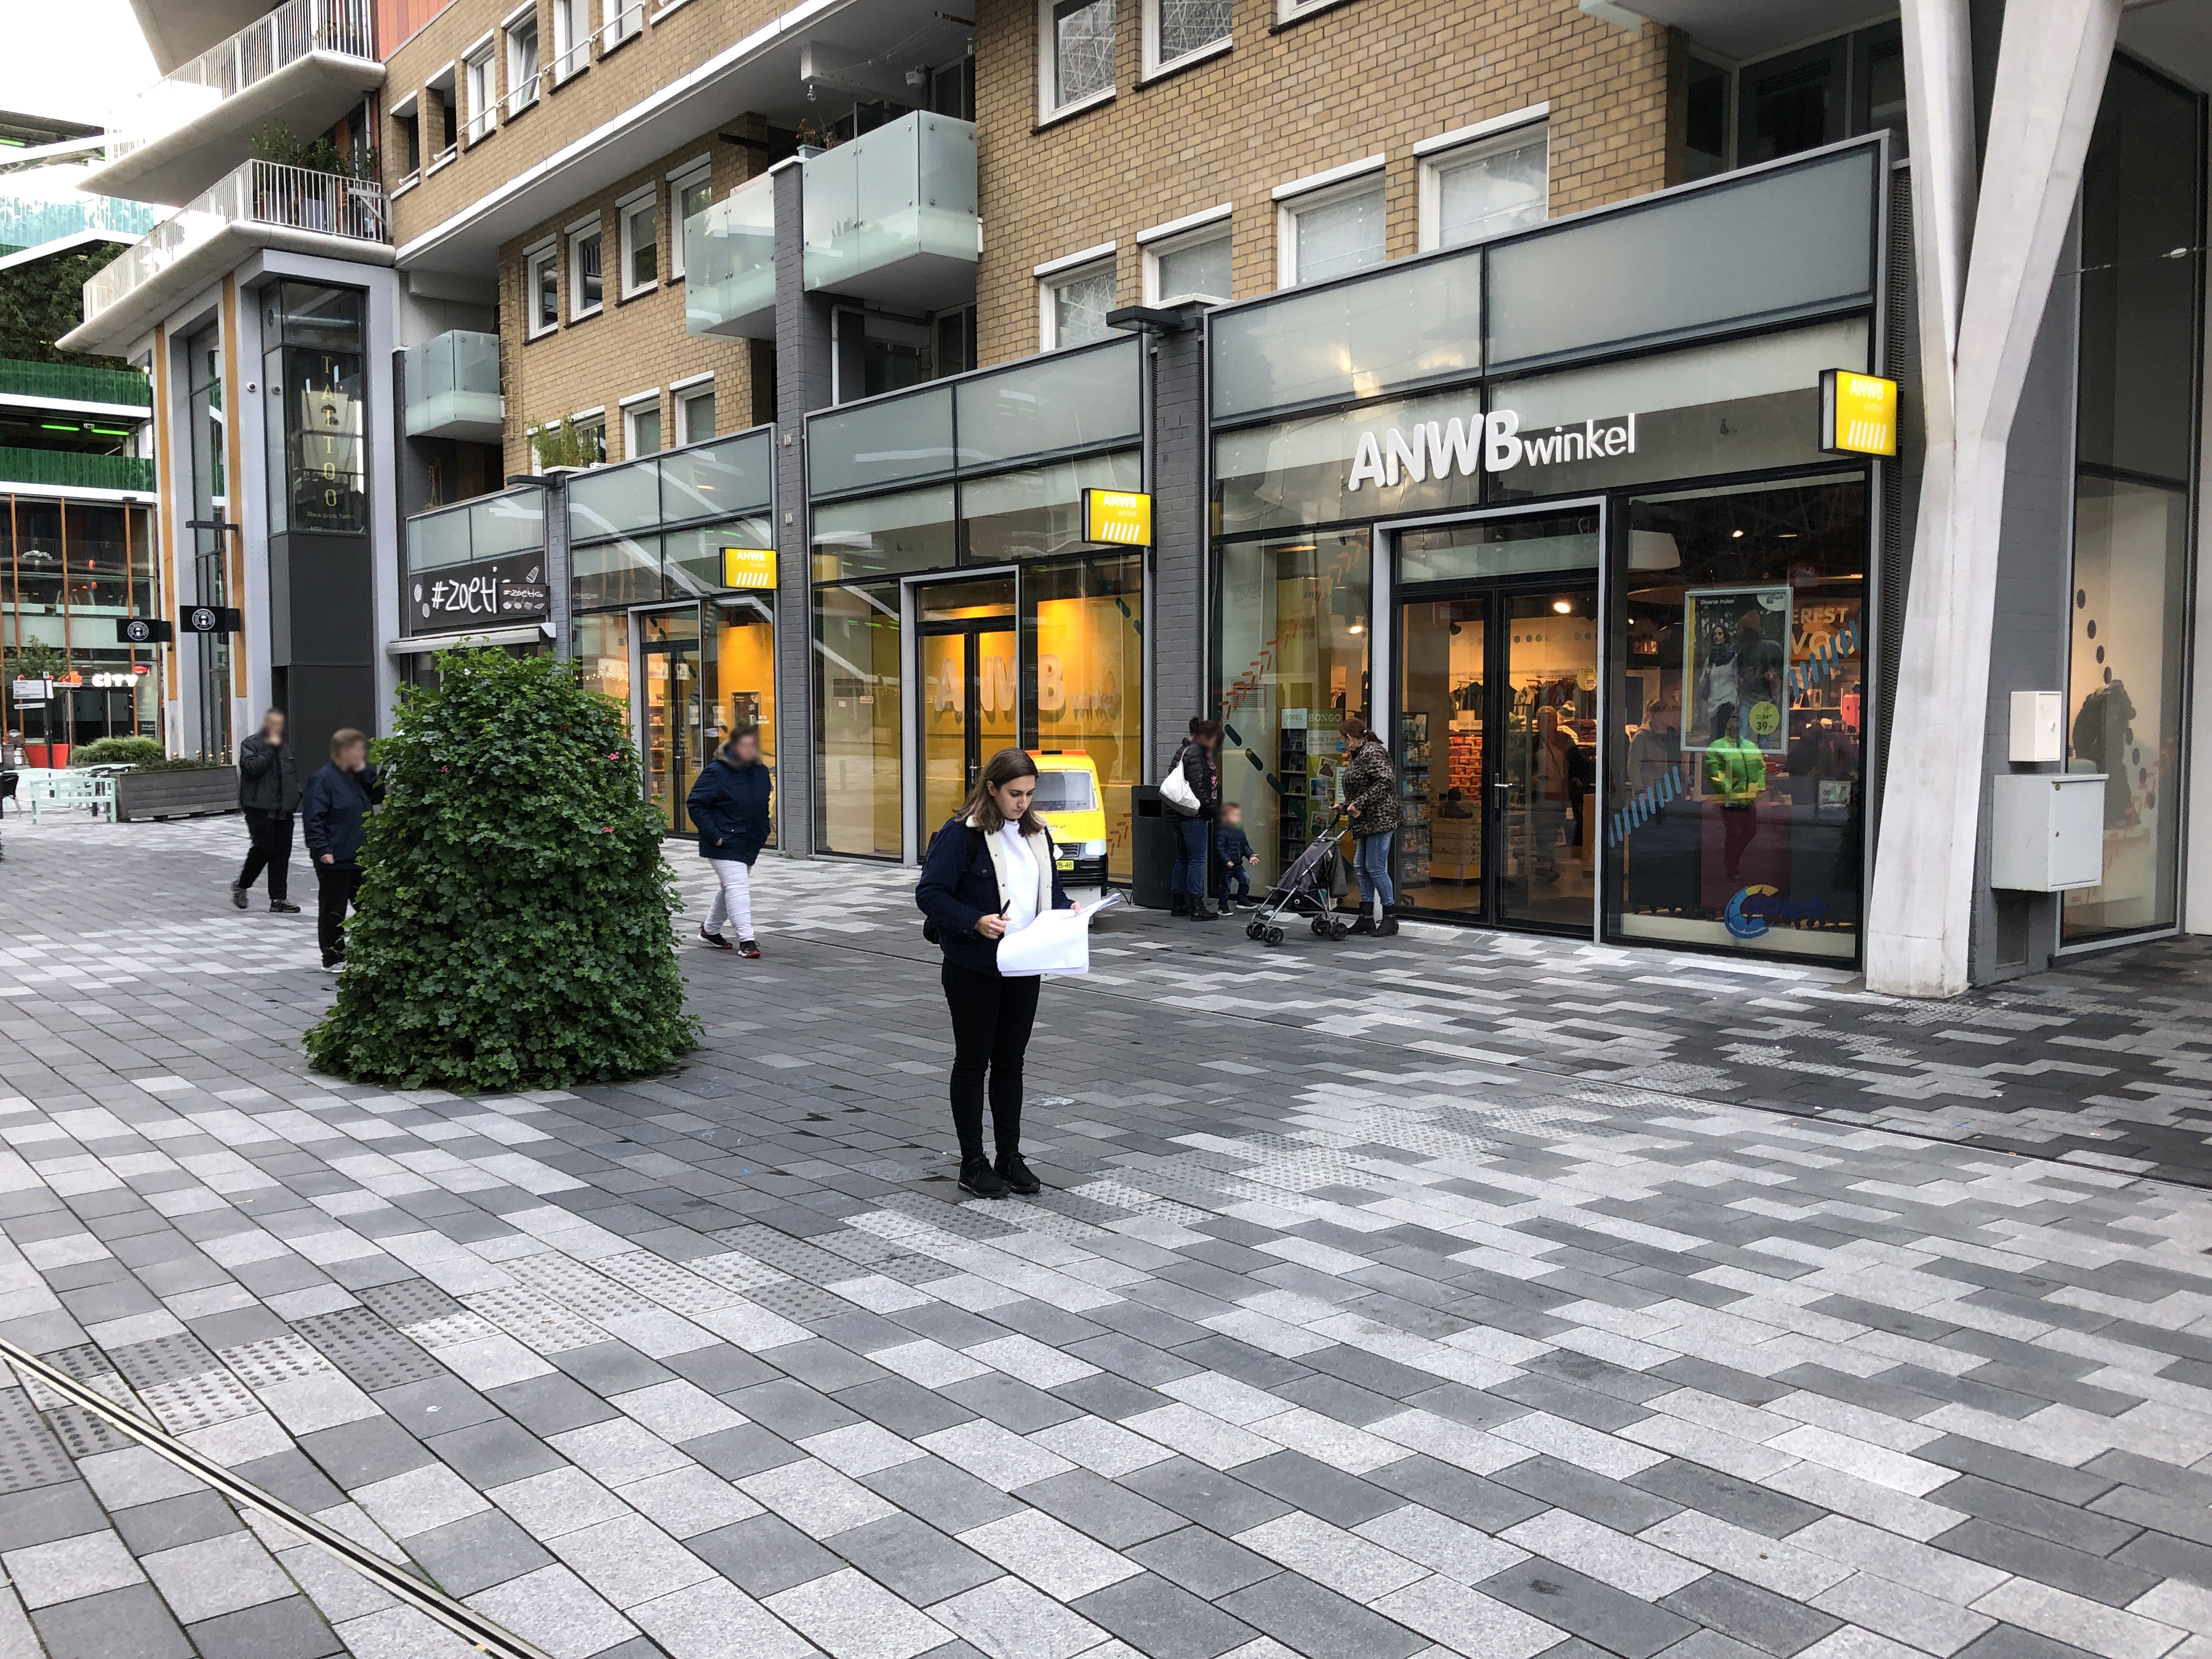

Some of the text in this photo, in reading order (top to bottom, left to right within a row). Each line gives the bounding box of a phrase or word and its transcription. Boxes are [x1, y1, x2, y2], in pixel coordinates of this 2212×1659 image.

[1850, 377, 1883, 400] ANWB
[321, 356, 337, 507] TATTOO
[1348, 409, 1635, 492] ANWB winkel
[1103, 493, 1137, 509] ANWB
[737, 551, 765, 561] ANWB
[431, 566, 511, 614] #zoeti
[1791, 607, 1849, 625] ERFST
[1308, 713, 1341, 723] BONGO
